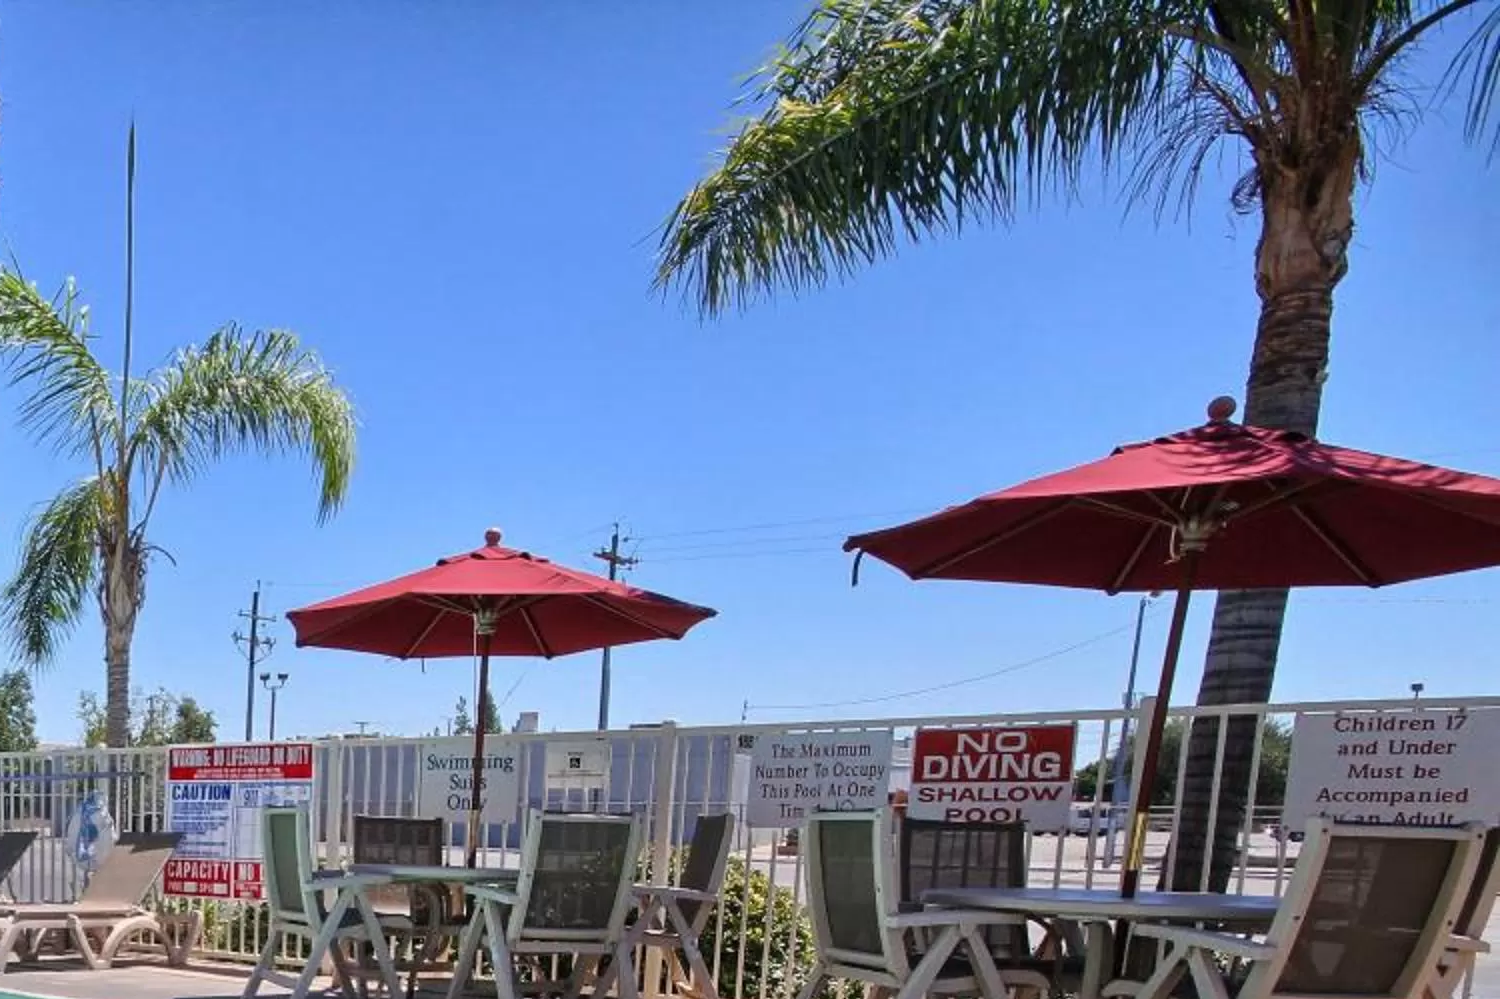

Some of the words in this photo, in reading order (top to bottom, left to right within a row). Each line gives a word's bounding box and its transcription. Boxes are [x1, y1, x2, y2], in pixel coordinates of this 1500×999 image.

[1334, 717, 1435, 733] Children
[1446, 715, 1468, 731] 17
[772, 743, 795, 758] The
[801, 743, 871, 758] Maximum
[957, 732, 1028, 753] NO
[1337, 740, 1378, 756] and
[1389, 738, 1457, 756] Under
[755, 764, 808, 779] Number
[814, 763, 829, 778] To
[833, 762, 885, 780] Occupy
[922, 752, 1061, 779] DIVING
[1347, 764, 1404, 779] Must
[1413, 764, 1441, 779] be
[449, 773, 488, 790] Suis
[761, 783, 789, 799] This
[794, 783, 821, 798] Pool
[847, 781, 876, 797] One
[171, 784, 231, 801] CAUTION
[918, 786, 1064, 802] SHALLOW
[1316, 787, 1470, 806] Accompanied
[447, 794, 488, 812] Ony
[946, 807, 1030, 823] POOL
[168, 861, 229, 881] CAPACITY
